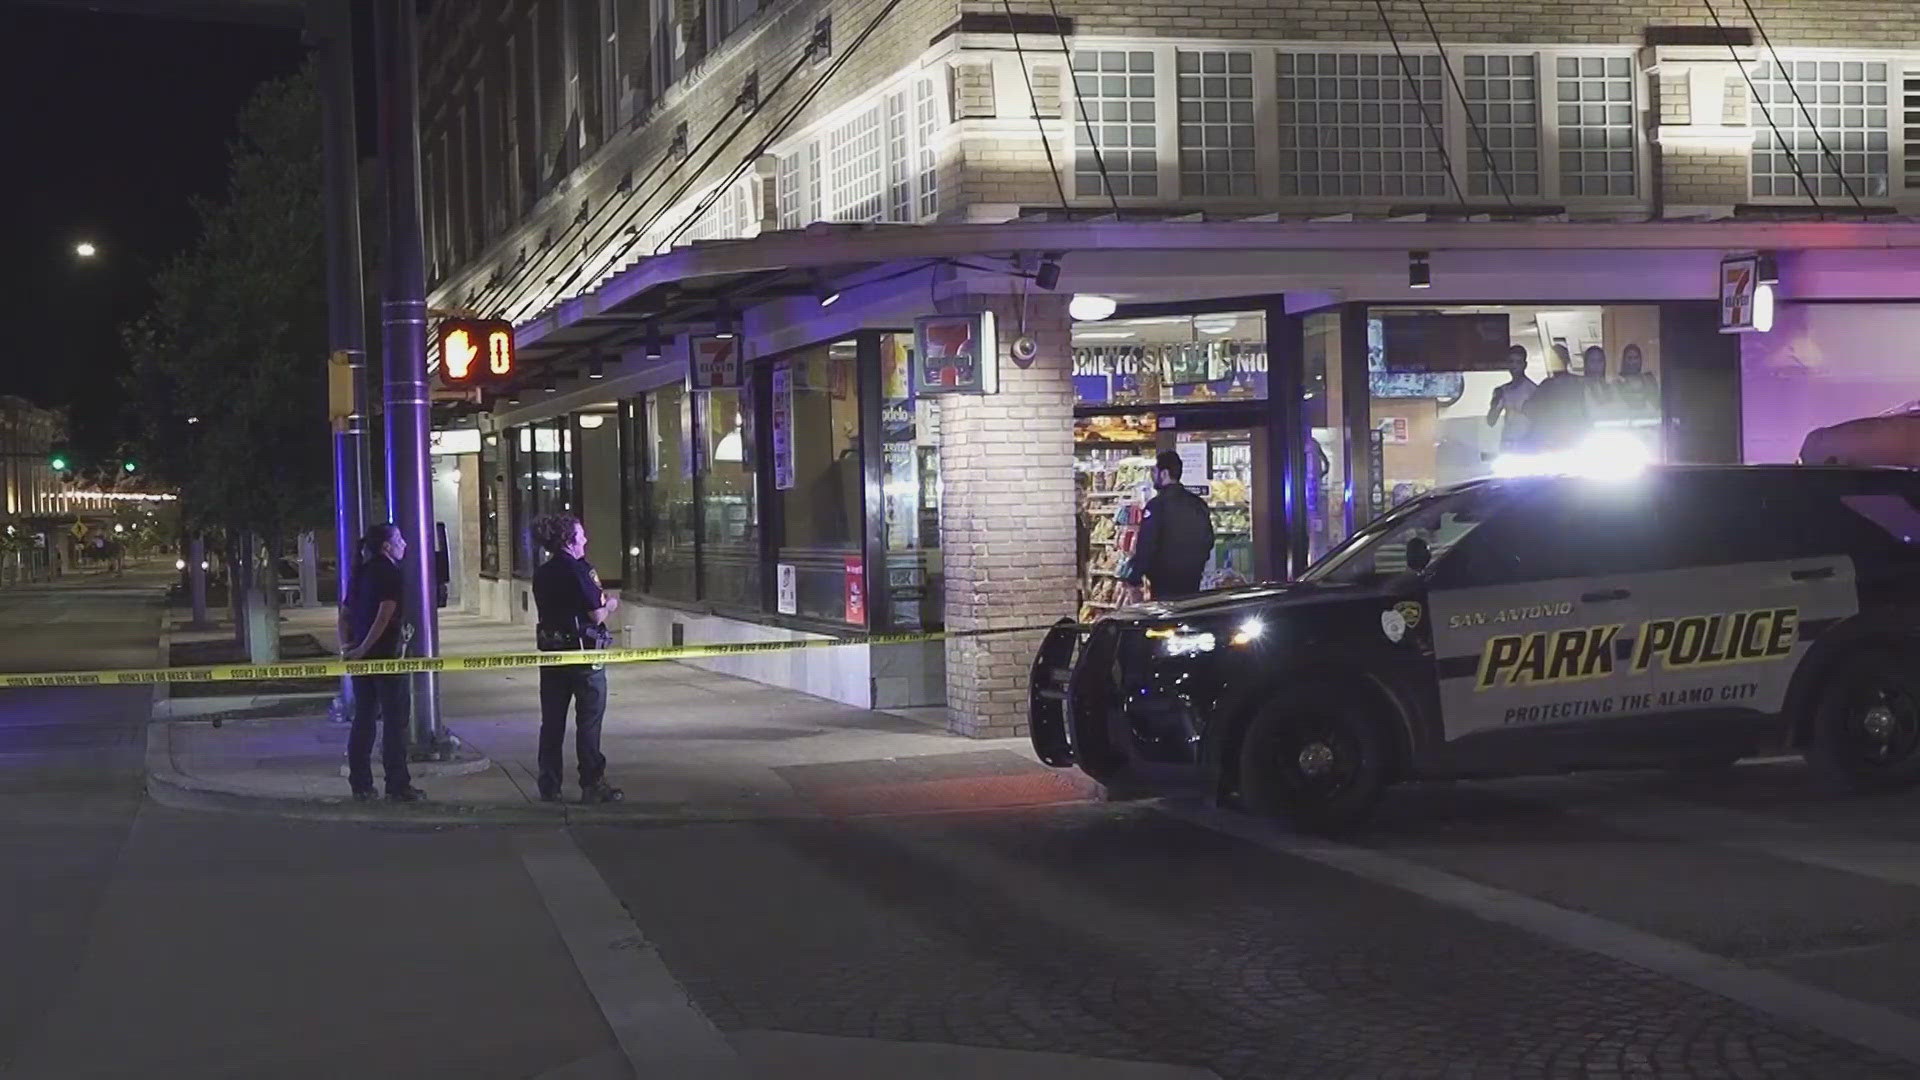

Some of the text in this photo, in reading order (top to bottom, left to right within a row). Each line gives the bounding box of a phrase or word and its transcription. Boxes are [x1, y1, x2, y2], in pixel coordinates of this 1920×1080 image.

[1727, 268, 1751, 324] 7
[489, 331, 511, 375] 0
[699, 341, 733, 388] 7
[926, 325, 968, 387] 7
[1449, 602, 1574, 629] SAN ANTONIO
[346, 659, 445, 674] CRIME SCENE DO NOT CROSS
[463, 655, 563, 668] CRIME SCENE DO NOT CROSS
[1477, 625, 1622, 691] PARK
[1631, 606, 1799, 675] POLICE
[230, 664, 328, 679] CRIME SCENE DO NOT CROSS
[1503, 683, 1759, 724] PROTECTING THE ALAMO CITY
